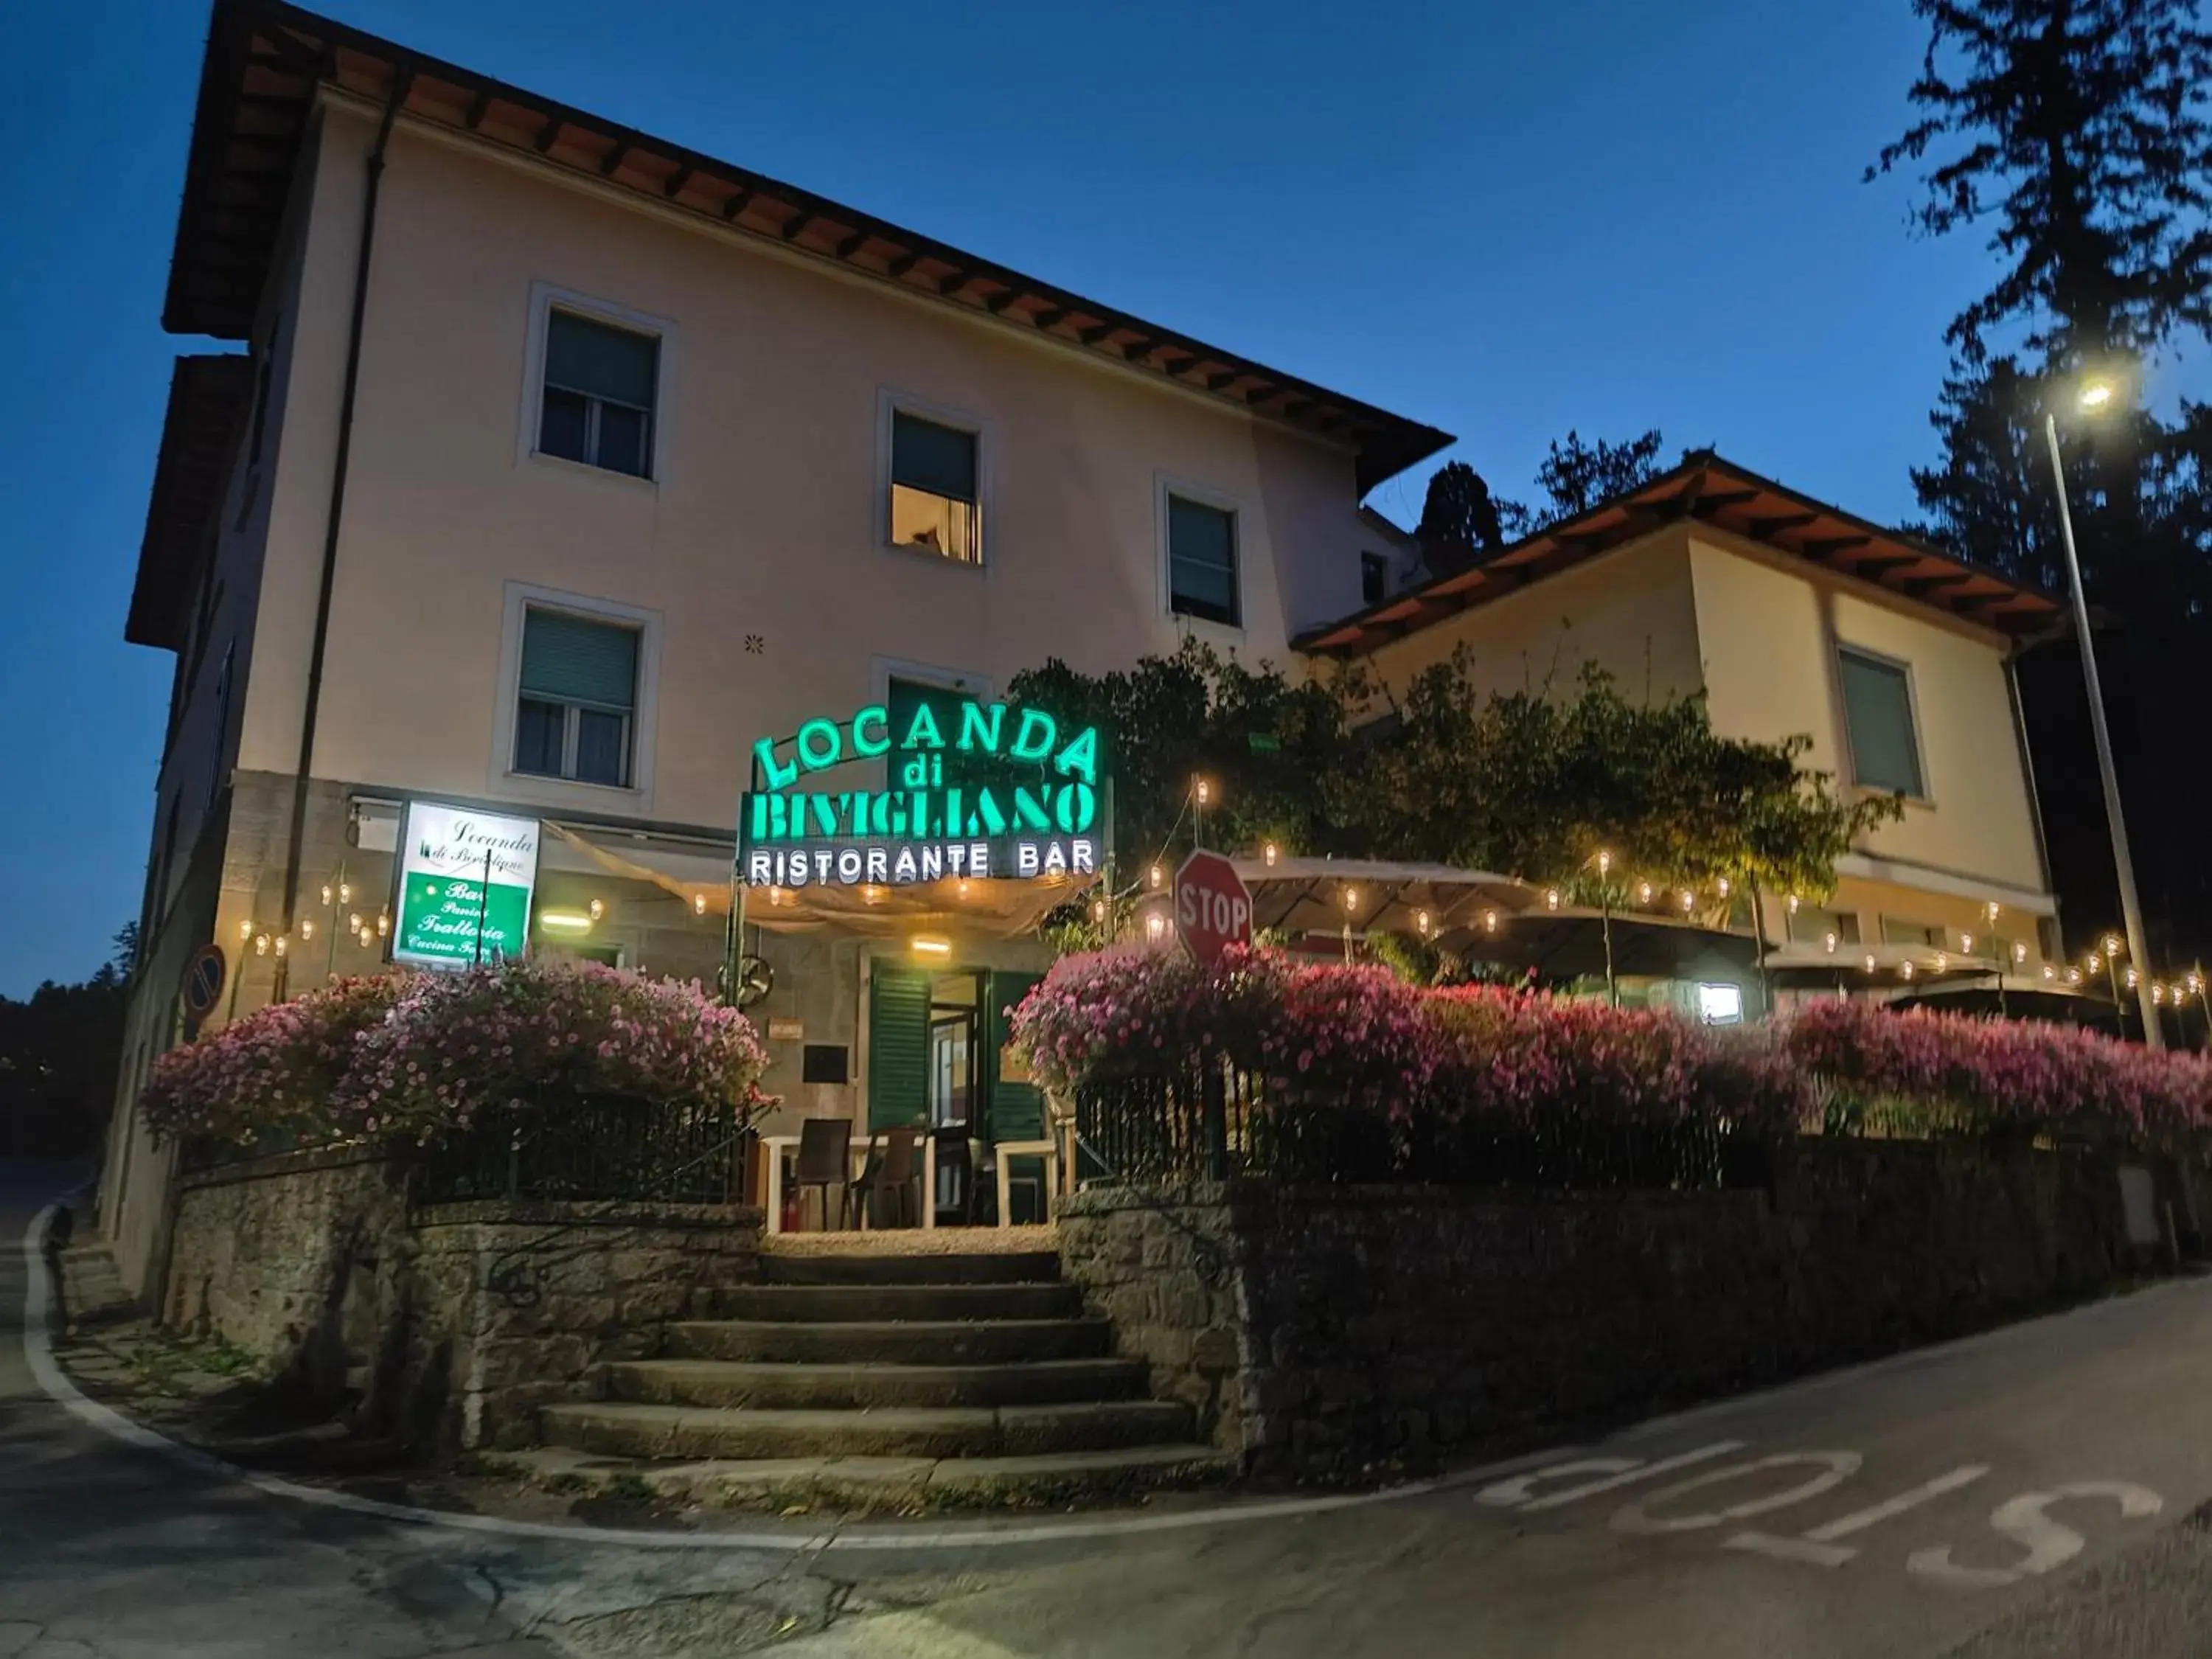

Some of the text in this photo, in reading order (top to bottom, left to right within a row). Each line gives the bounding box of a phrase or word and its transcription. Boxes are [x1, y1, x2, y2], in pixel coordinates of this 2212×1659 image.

[754, 701, 1097, 791] LOCANDA
[904, 753, 942, 787] di
[454, 819, 532, 852] Locanda
[751, 783, 1096, 839] BIVIGLIANO
[751, 840, 1093, 884] RISTORANTE BAR
[1180, 883, 1248, 939] STOP
